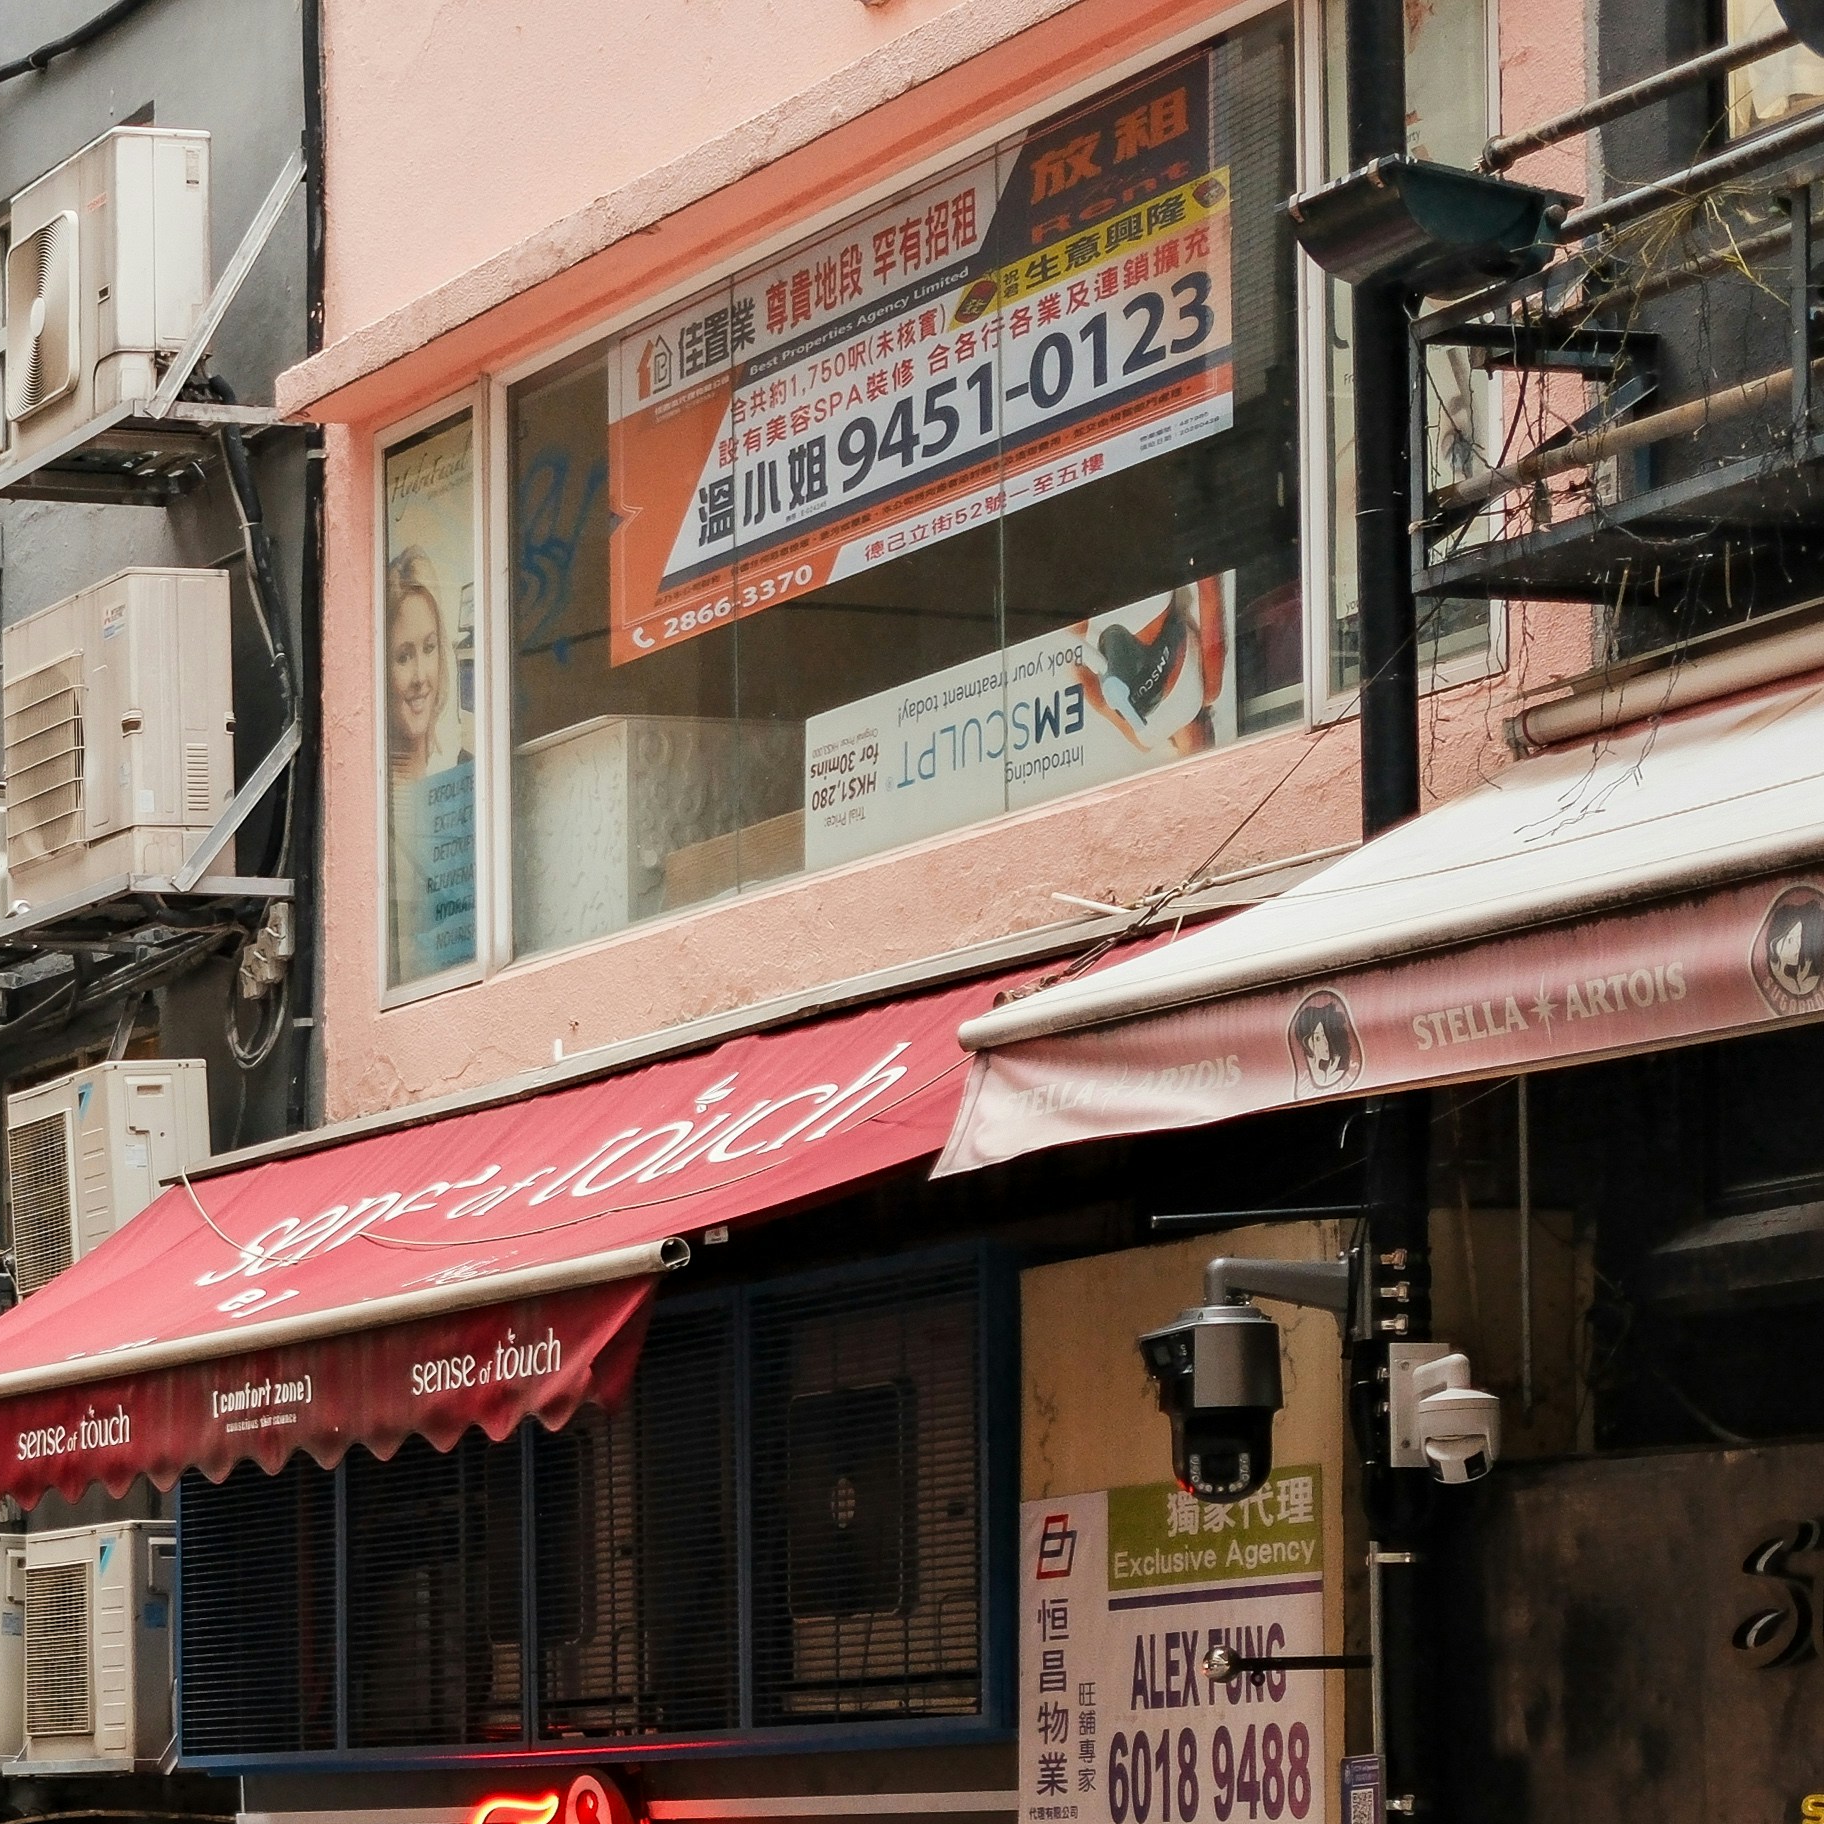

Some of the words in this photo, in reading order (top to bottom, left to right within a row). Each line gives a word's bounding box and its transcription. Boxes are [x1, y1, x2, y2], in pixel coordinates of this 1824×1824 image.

[1030, 86, 1190, 206] 放租
[1025, 193, 1187, 290] 生意興隆
[678, 297, 756, 380] 佳置業
[765, 243, 864, 334] 尊貴地段
[872, 186, 979, 287] 罕有招租
[748, 357, 779, 377] Best
[782, 318, 854, 362] Properties
[857, 293, 911, 328] Agency
[913, 266, 970, 301] Limited
[697, 435, 830, 548] 溫小姐
[838, 269, 1215, 494] 9451-0123
[863, 452, 1105, 563] 德己立街52號一至五樓
[663, 563, 814, 640] 2866-3370
[947, 666, 1008, 704] treatment
[1012, 653, 1044, 681] your
[1047, 644, 1083, 670] Book
[897, 690, 940, 728] today!
[810, 751, 856, 781] 30mins
[859, 742, 881, 764] for
[1005, 744, 1085, 785] Introducing
[812, 771, 878, 812] HK$1,280
[1413, 1000, 1530, 1053] STELLA
[1565, 962, 1689, 1021] ARTOIS
[1126, 1053, 1244, 1098] ARTOIS
[411, 1353, 477, 1397] sense
[479, 1361, 495, 1385] of
[495, 1327, 563, 1382] touch
[17, 1424, 66, 1462] sense
[66, 1433, 79, 1454] of
[80, 1402, 131, 1452] touch
[1112, 1550, 1217, 1579] Exclusive
[1225, 1538, 1316, 1570] Agency
[1036, 1597, 1069, 1797] 恒昌物業
[1131, 1630, 1201, 1711] ALEX
[1208, 1622, 1287, 1708] FUNG
[1211, 1721, 1313, 1824] 9488
